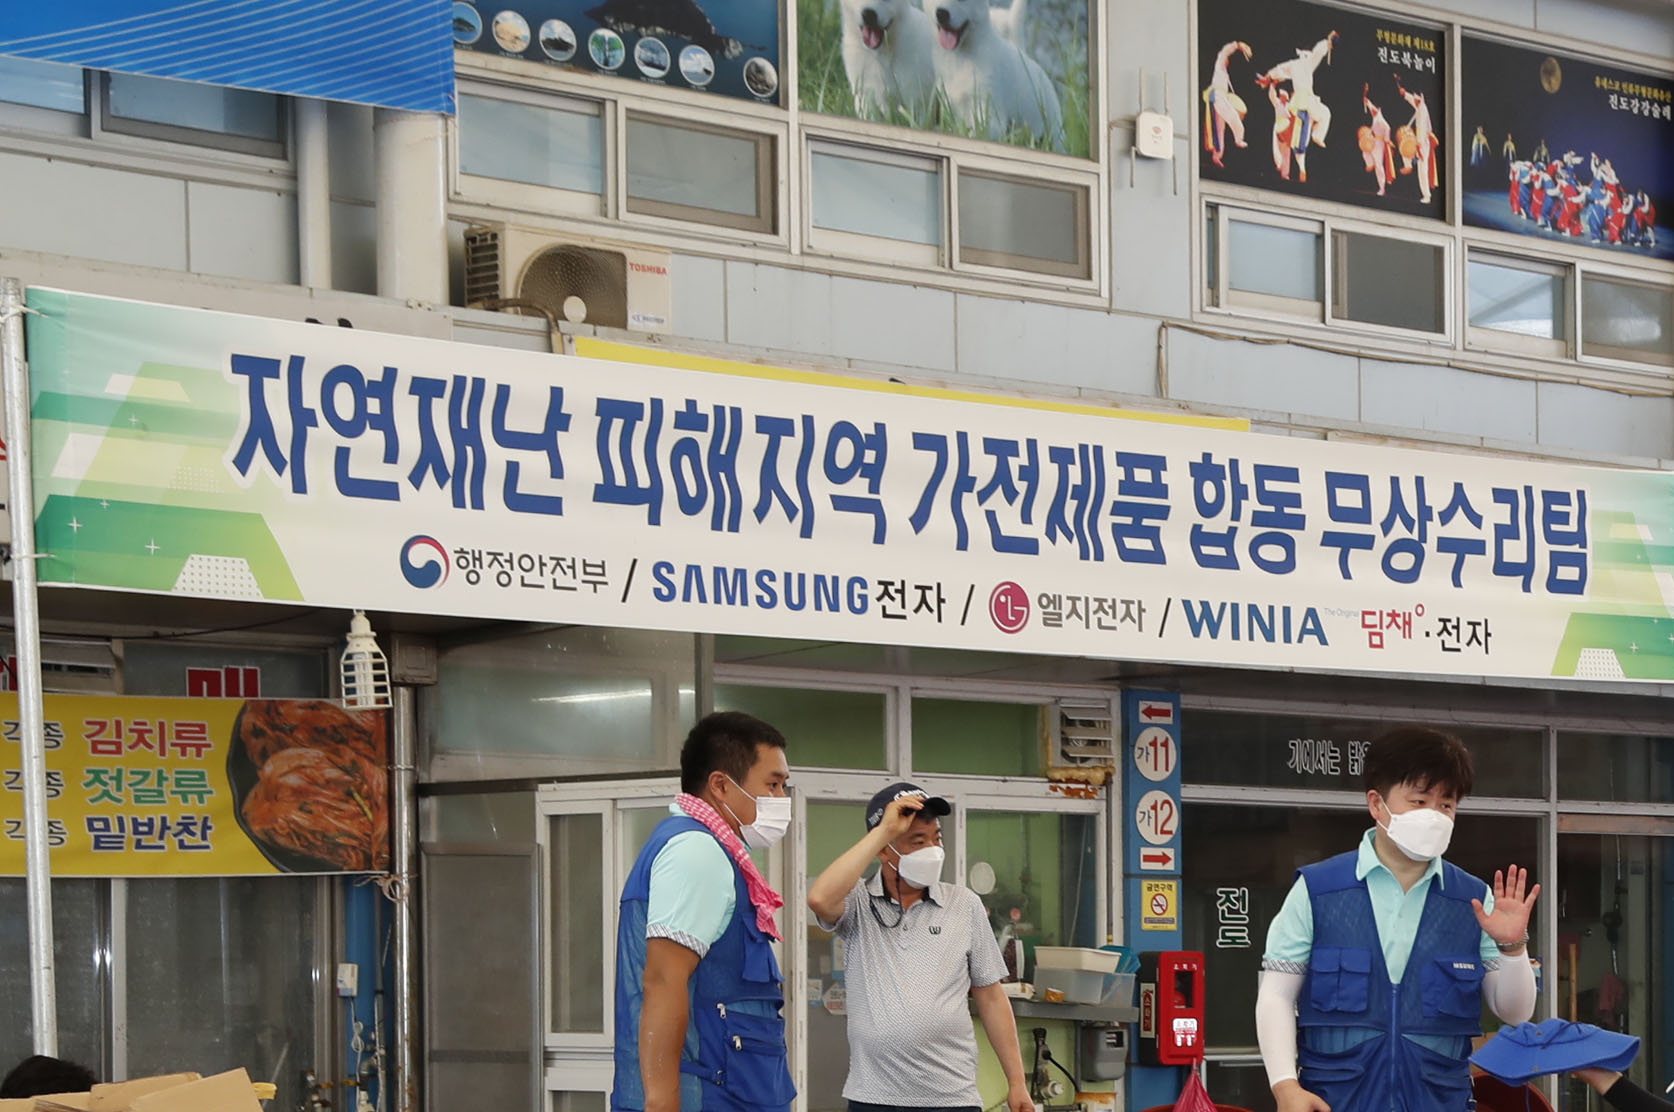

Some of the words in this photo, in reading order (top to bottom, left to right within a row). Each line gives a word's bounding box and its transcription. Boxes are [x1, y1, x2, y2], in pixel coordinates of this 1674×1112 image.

[1377, 46, 1436, 74] 진도북놀이
[1608, 93, 1672, 121] 진도강강술래
[629, 262, 668, 276] TOSHIBA
[231, 353, 570, 516] 자연재난
[593, 397, 888, 546] 피해지역
[908, 430, 1172, 566] 가전제품
[1188, 452, 1307, 575] 합동
[1320, 470, 1590, 596] 무상수리팀
[453, 546, 610, 595] 행정안전부
[1037, 591, 1147, 633] 엘지전자
[1181, 599, 1330, 647] WINIA
[1361, 608, 1413, 650] 딤채
[83, 718, 213, 759] 김치류
[82, 767, 215, 805] 젓갈류
[86, 815, 214, 851] 밑반찬
[1146, 882, 1173, 892] 금연구역
[1216, 887, 1252, 949] 진도
